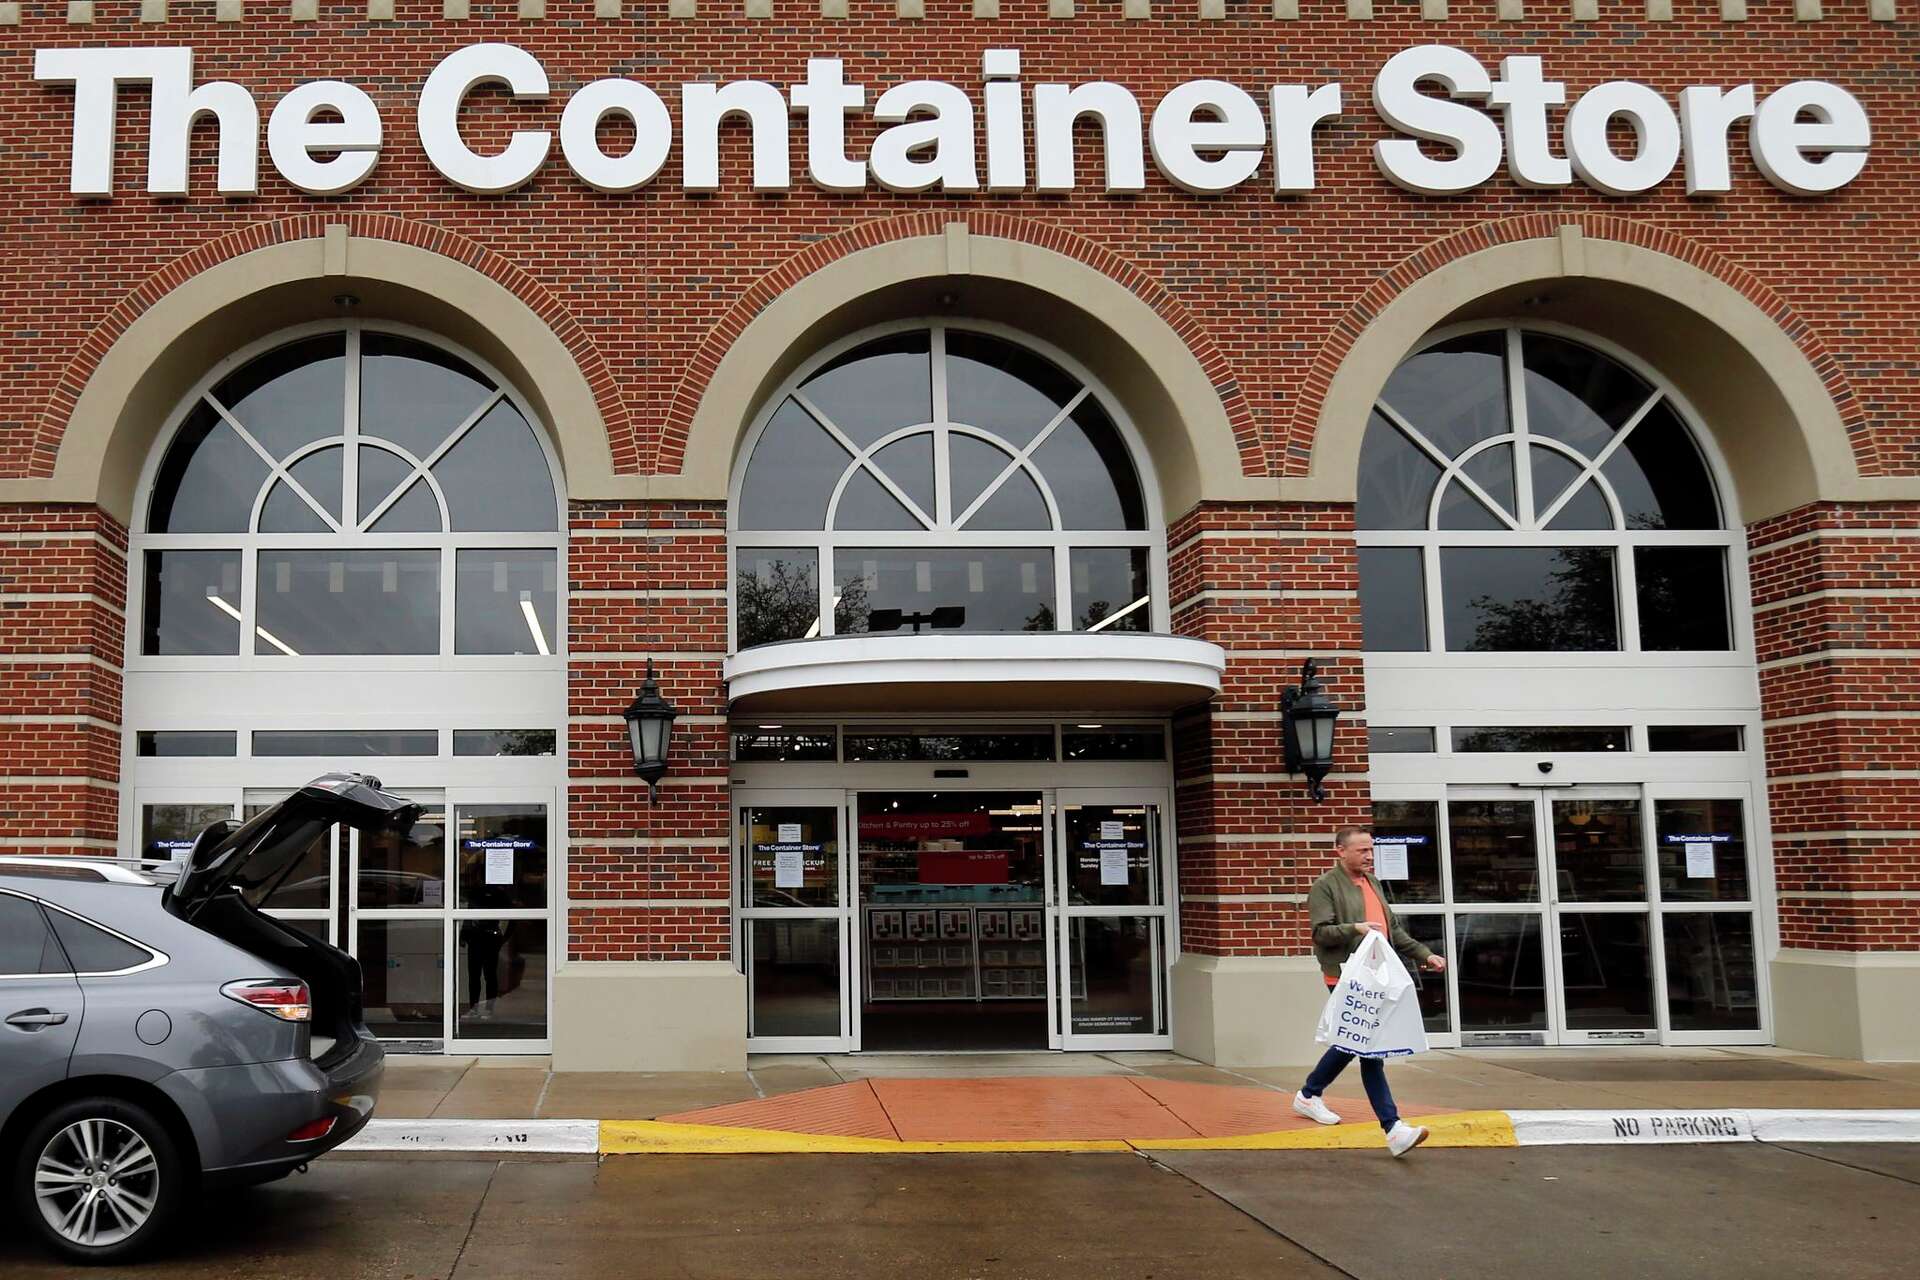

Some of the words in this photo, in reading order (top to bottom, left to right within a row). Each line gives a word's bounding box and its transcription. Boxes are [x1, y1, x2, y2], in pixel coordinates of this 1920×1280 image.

[34, 46, 383, 197] The
[418, 42, 1342, 196] Container
[1372, 44, 1872, 197] Store
[893, 821, 918, 830] Pantry
[919, 822, 930, 830] up
[959, 820, 970, 828] off
[1611, 1117, 1640, 1137] NO
[1650, 1116, 1739, 1137] PARKING
